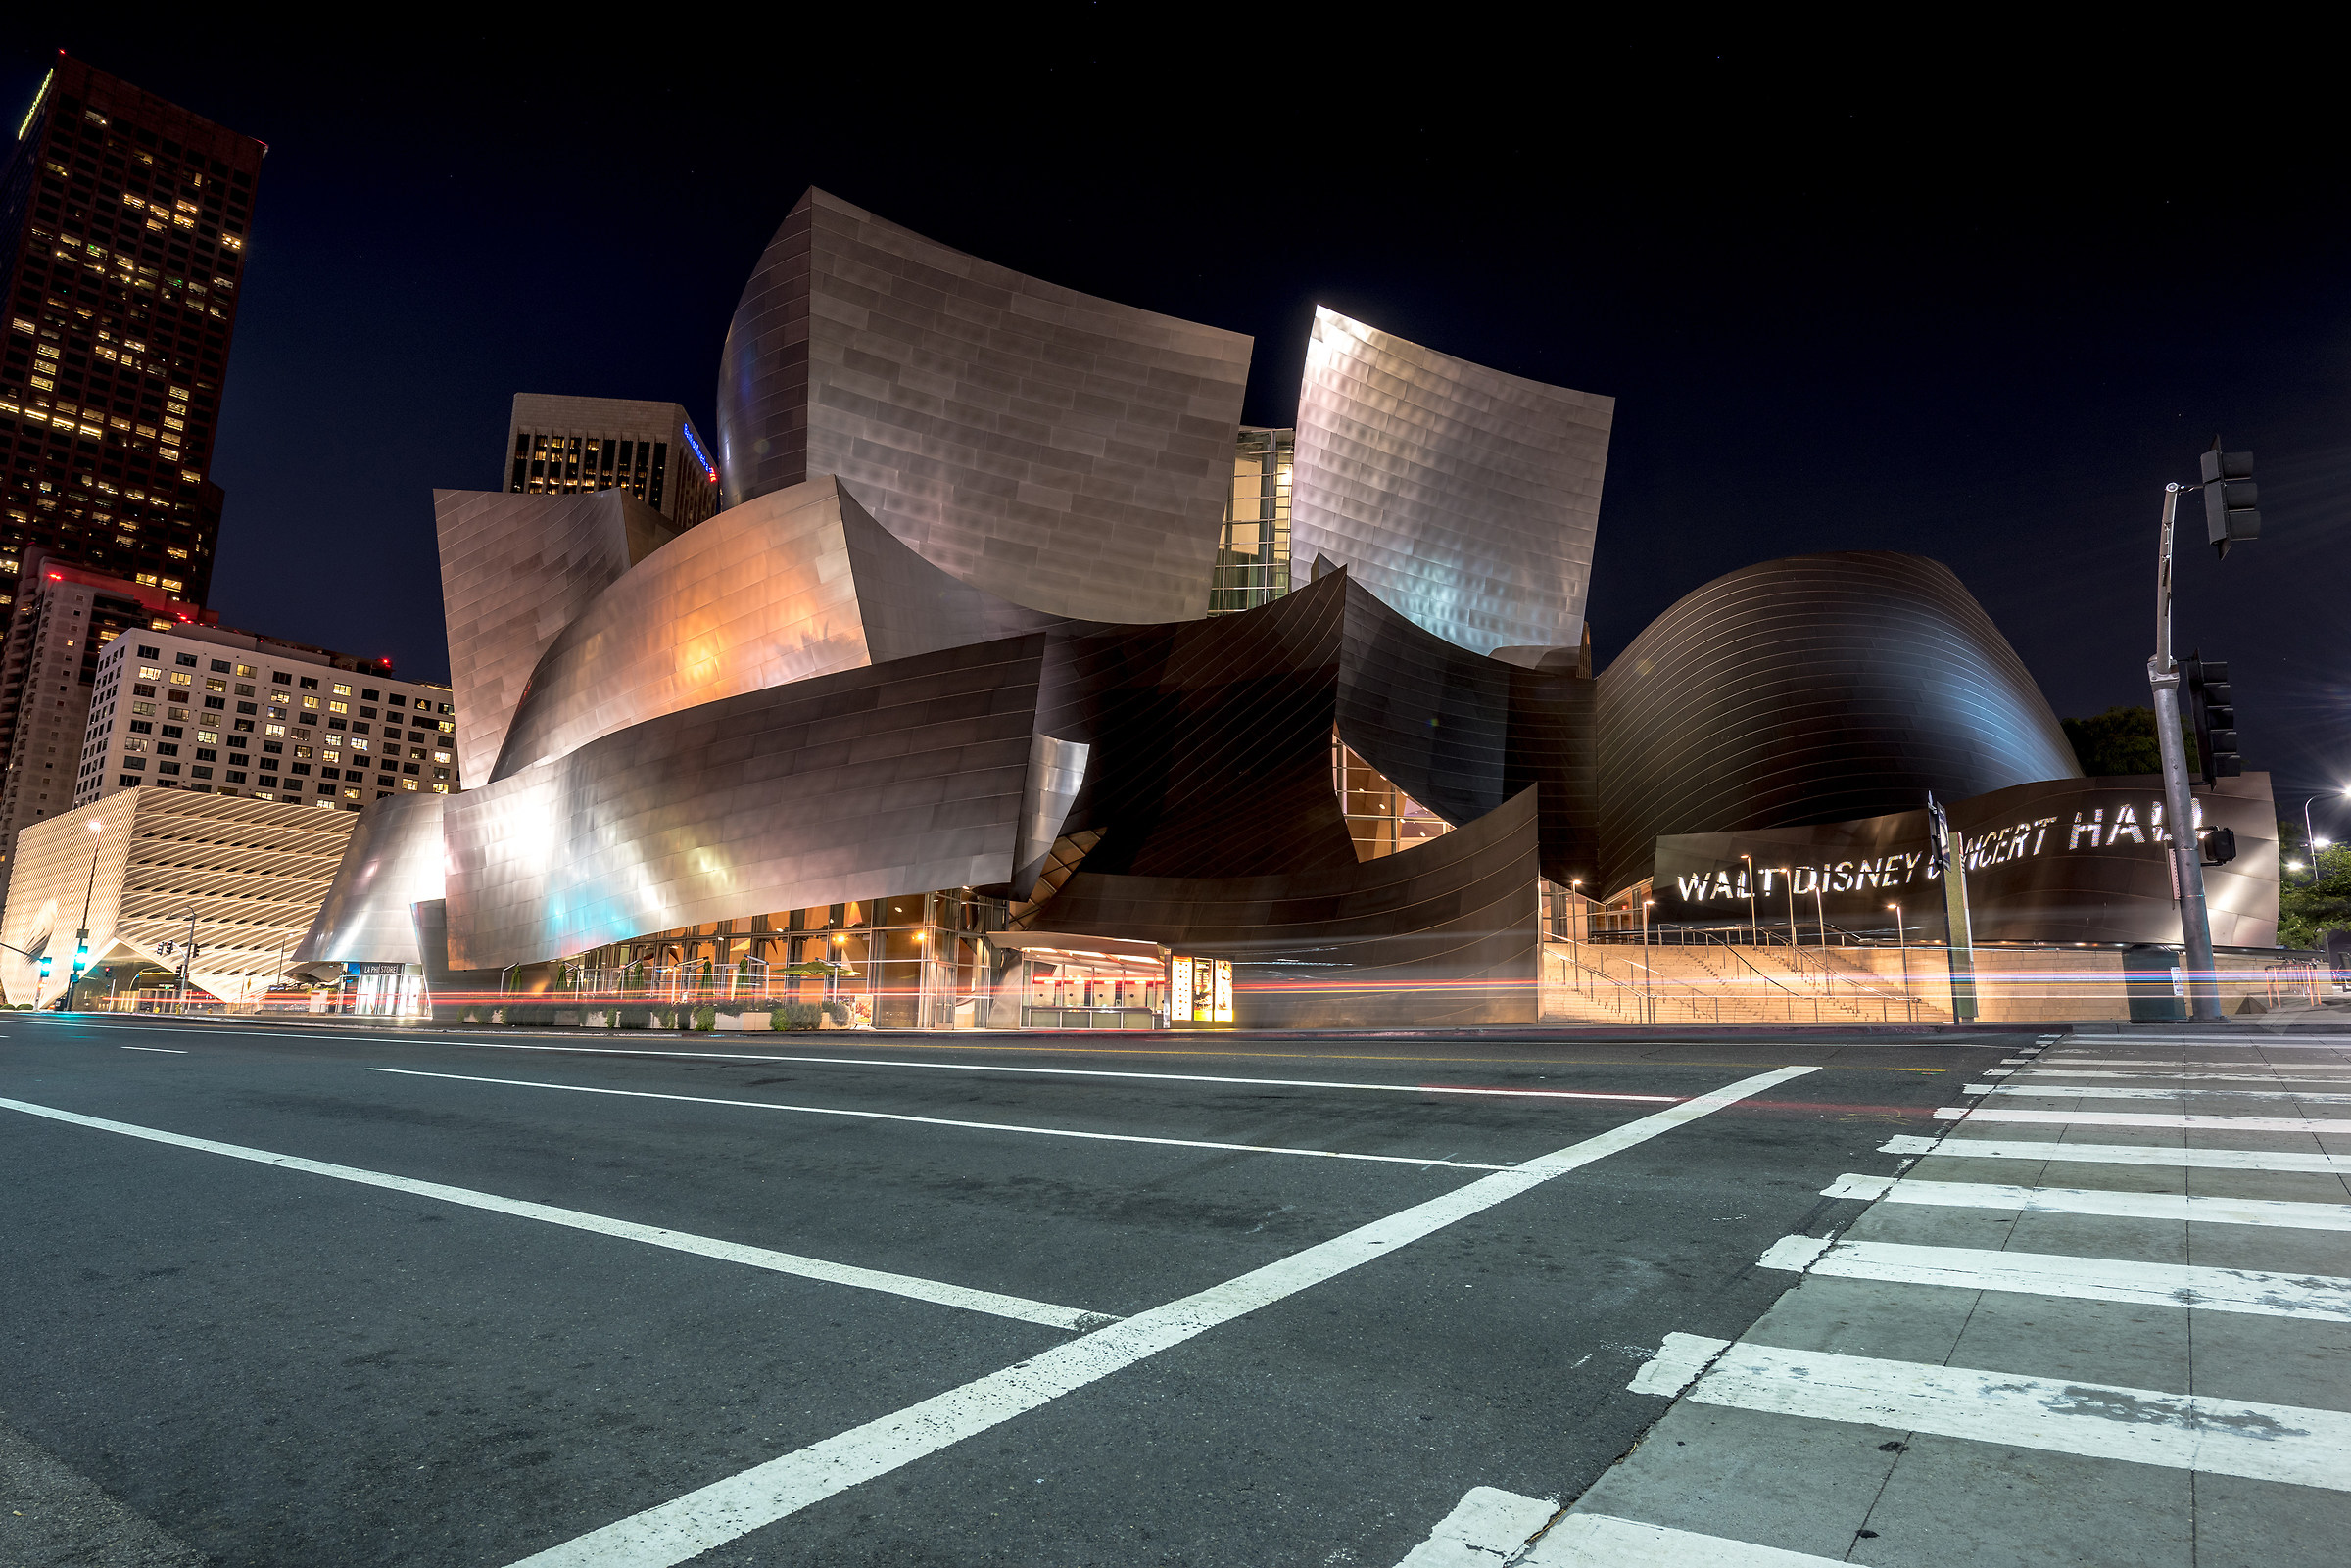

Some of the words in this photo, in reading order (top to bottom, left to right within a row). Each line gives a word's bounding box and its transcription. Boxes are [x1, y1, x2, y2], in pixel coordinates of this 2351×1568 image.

[1677, 868, 1786, 902] WALT
[1792, 850, 1923, 895] DISNEY
[1927, 816, 2058, 879] CNCERT
[2068, 796, 2211, 851] HALL
[380, 965, 397, 974] STORE
